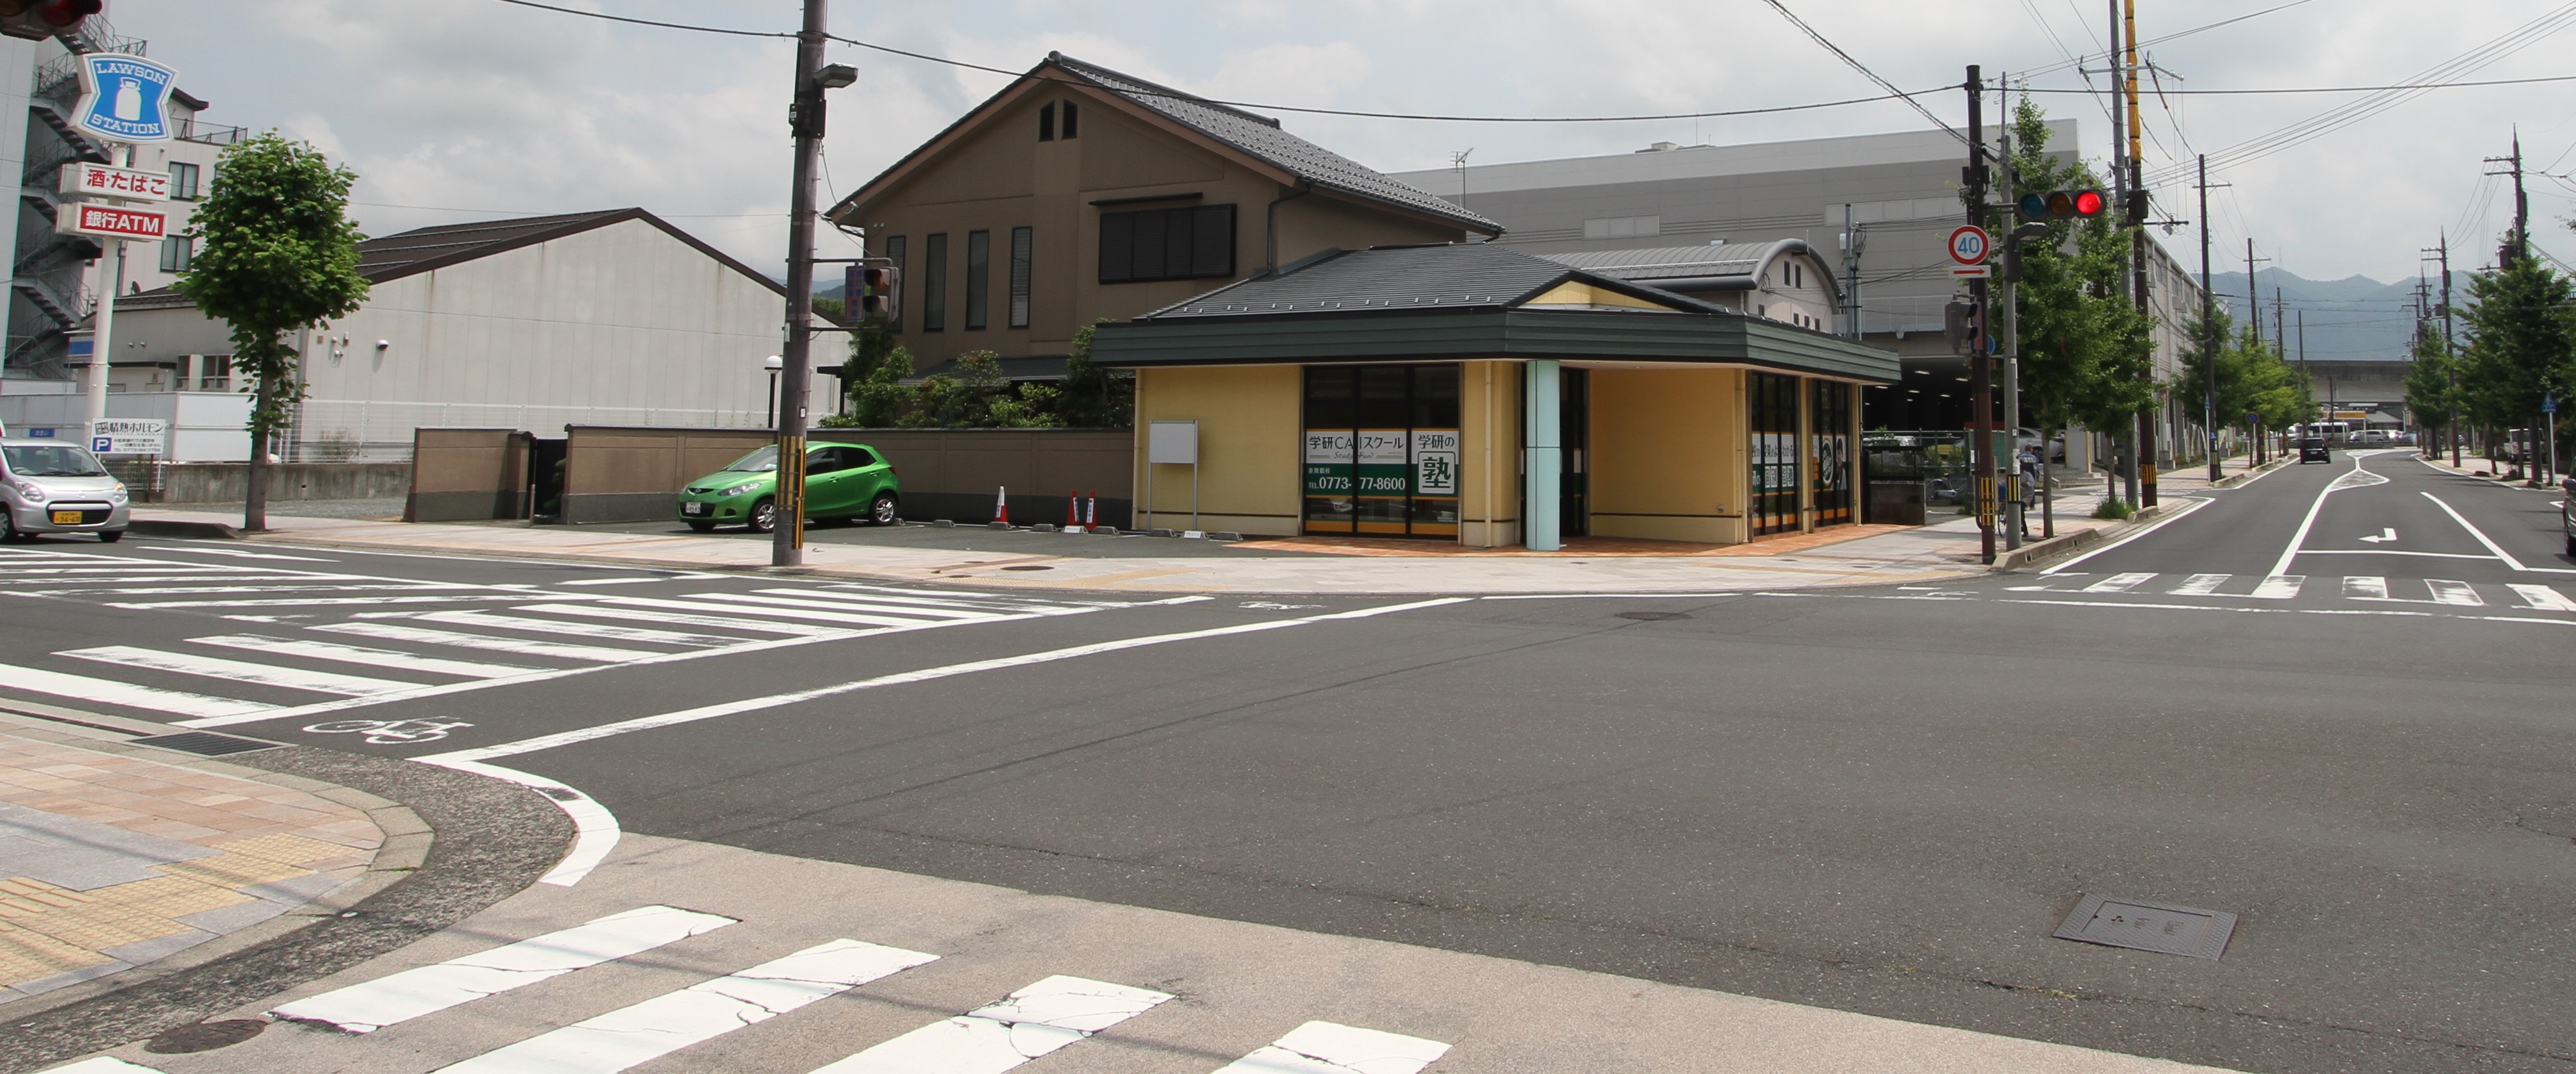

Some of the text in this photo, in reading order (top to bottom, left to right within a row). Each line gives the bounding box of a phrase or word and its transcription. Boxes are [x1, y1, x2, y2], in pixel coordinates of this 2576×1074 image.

[95, 63, 166, 85] LAWSON
[91, 113, 160, 134] STATION
[87, 169, 166, 195] 酒・たばこ
[85, 210, 160, 232] 銀行ATM
[1958, 236, 1979, 254] 40
[109, 422, 164, 433] 情熱ホルモン
[96, 439, 109, 450] P
[1418, 434, 1455, 449] 学研の
[1422, 457, 1451, 488] 塾
